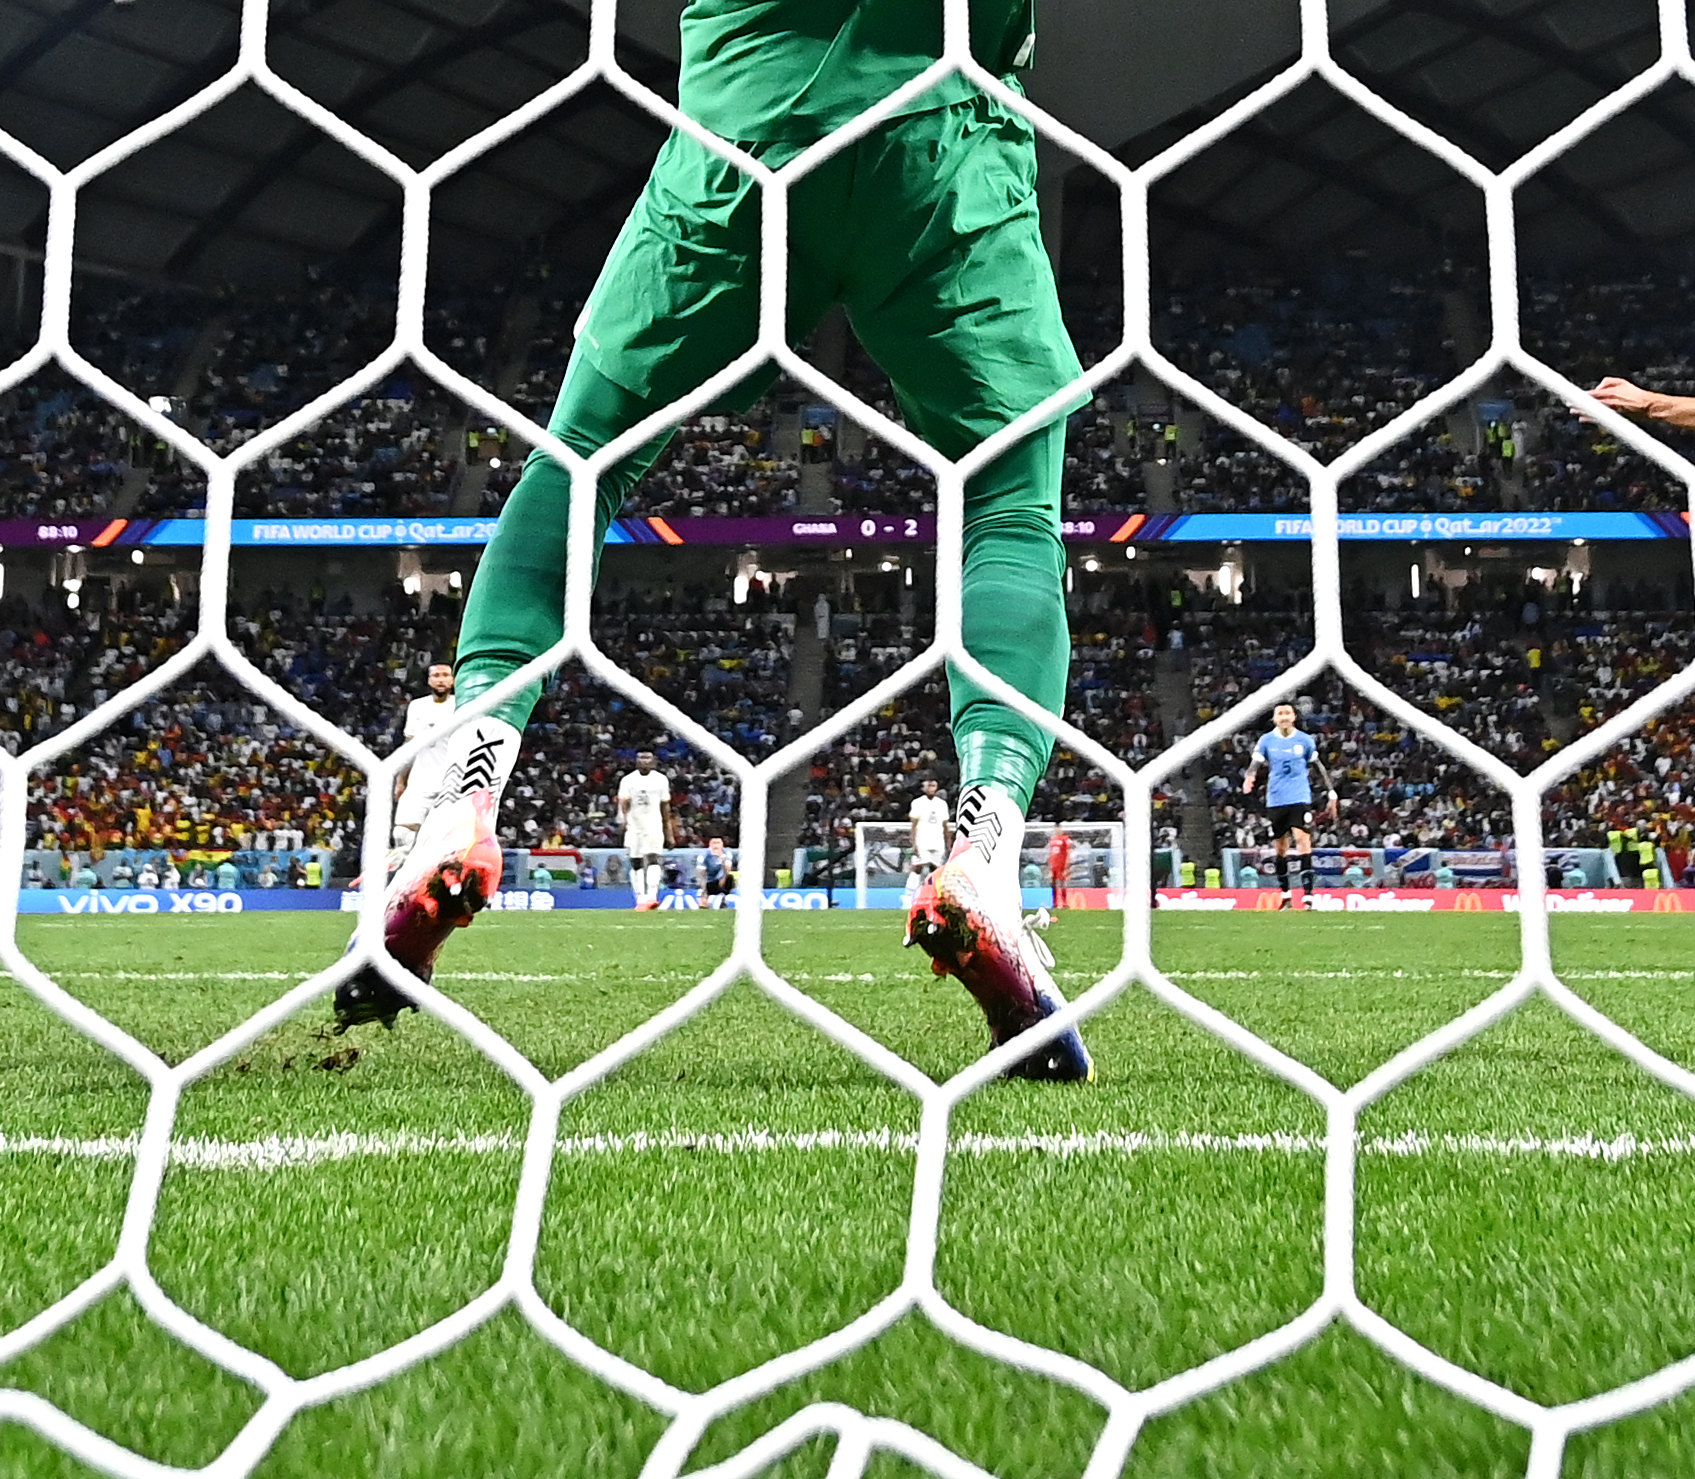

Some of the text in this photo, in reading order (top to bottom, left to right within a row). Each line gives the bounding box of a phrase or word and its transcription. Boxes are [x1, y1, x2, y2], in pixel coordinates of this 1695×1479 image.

[254, 524, 291, 540] FIFA
[292, 524, 355, 540] WORLD
[357, 523, 392, 539] CUP
[860, 519, 876, 536] 0
[904, 519, 918, 536] 2
[1274, 519, 1313, 534] FIFA
[1382, 518, 1418, 534] CUP
[1282, 760, 1292, 775] 5
[58, 888, 242, 913] vivo X90
[1345, 891, 1434, 911] Deliver
